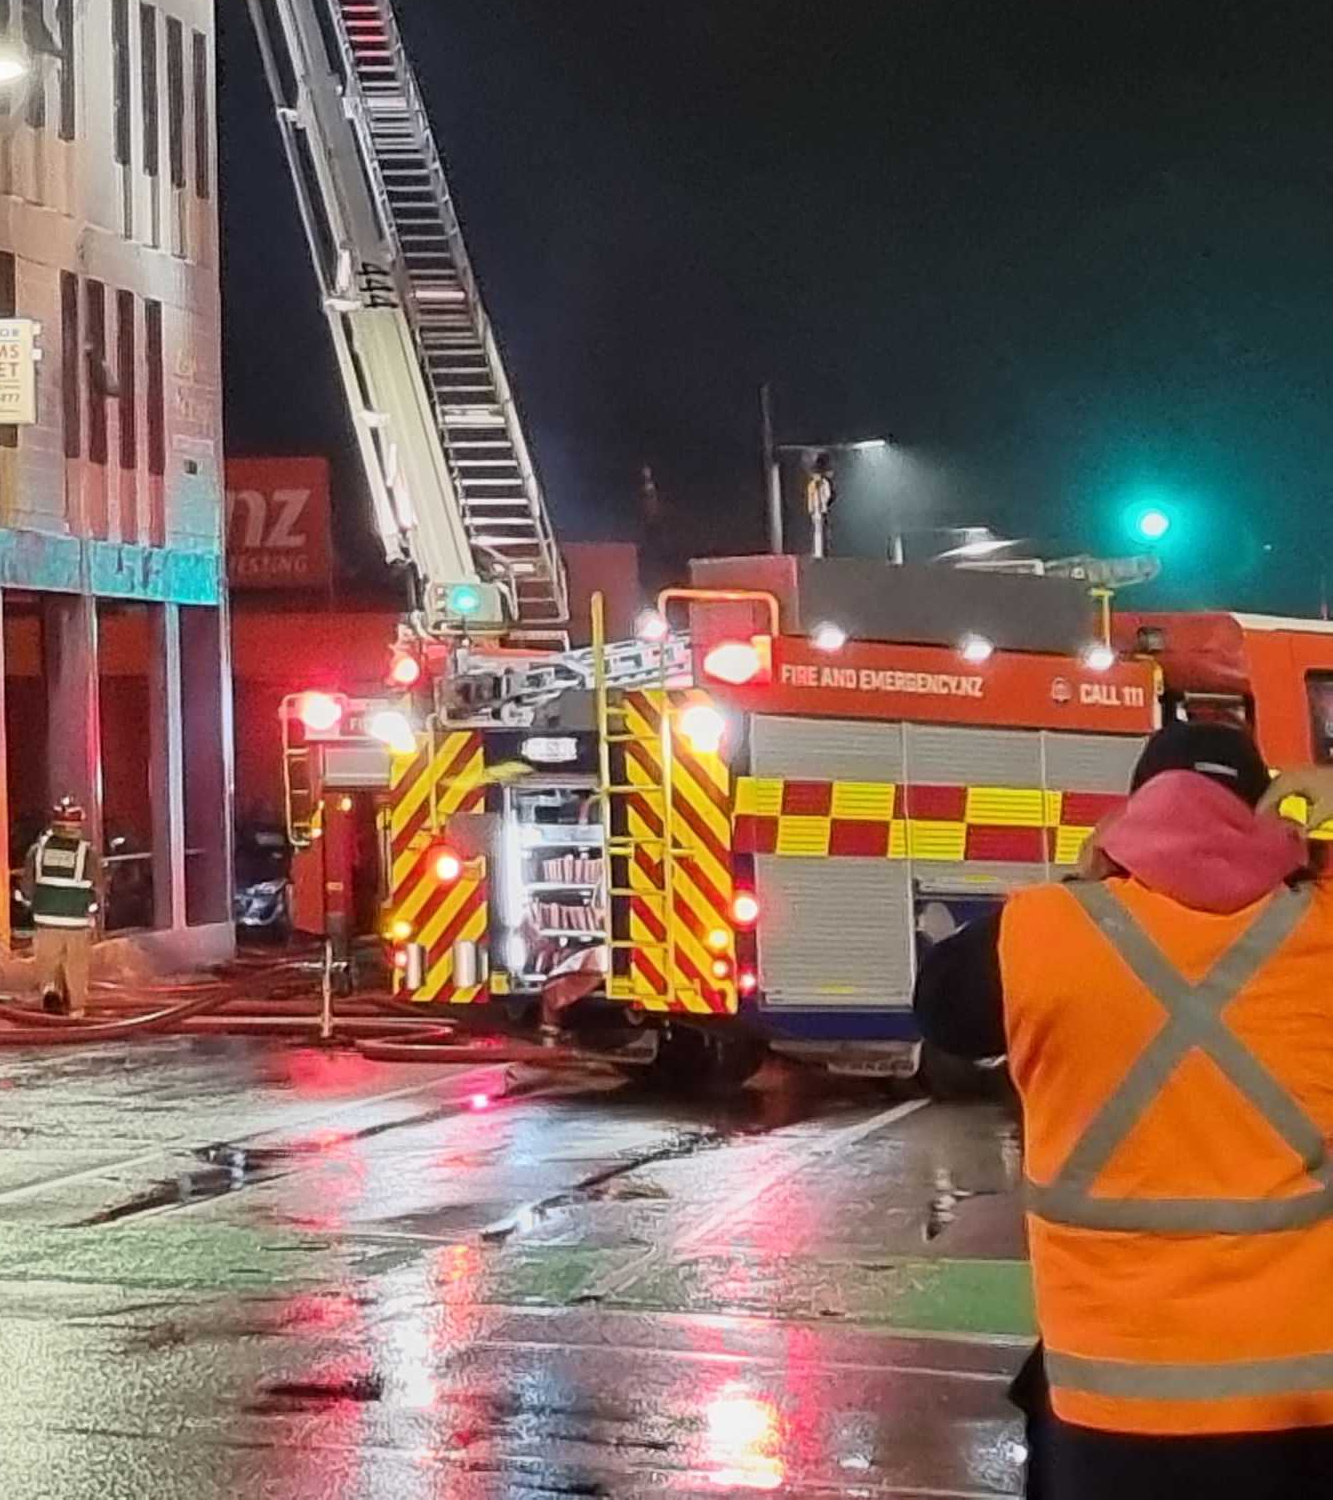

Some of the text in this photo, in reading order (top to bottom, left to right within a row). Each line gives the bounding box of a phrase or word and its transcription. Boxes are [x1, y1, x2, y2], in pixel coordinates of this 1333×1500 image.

[781, 664, 818, 687] FIRE
[821, 667, 858, 688] AND
[1079, 682, 1145, 707] CALL 111
